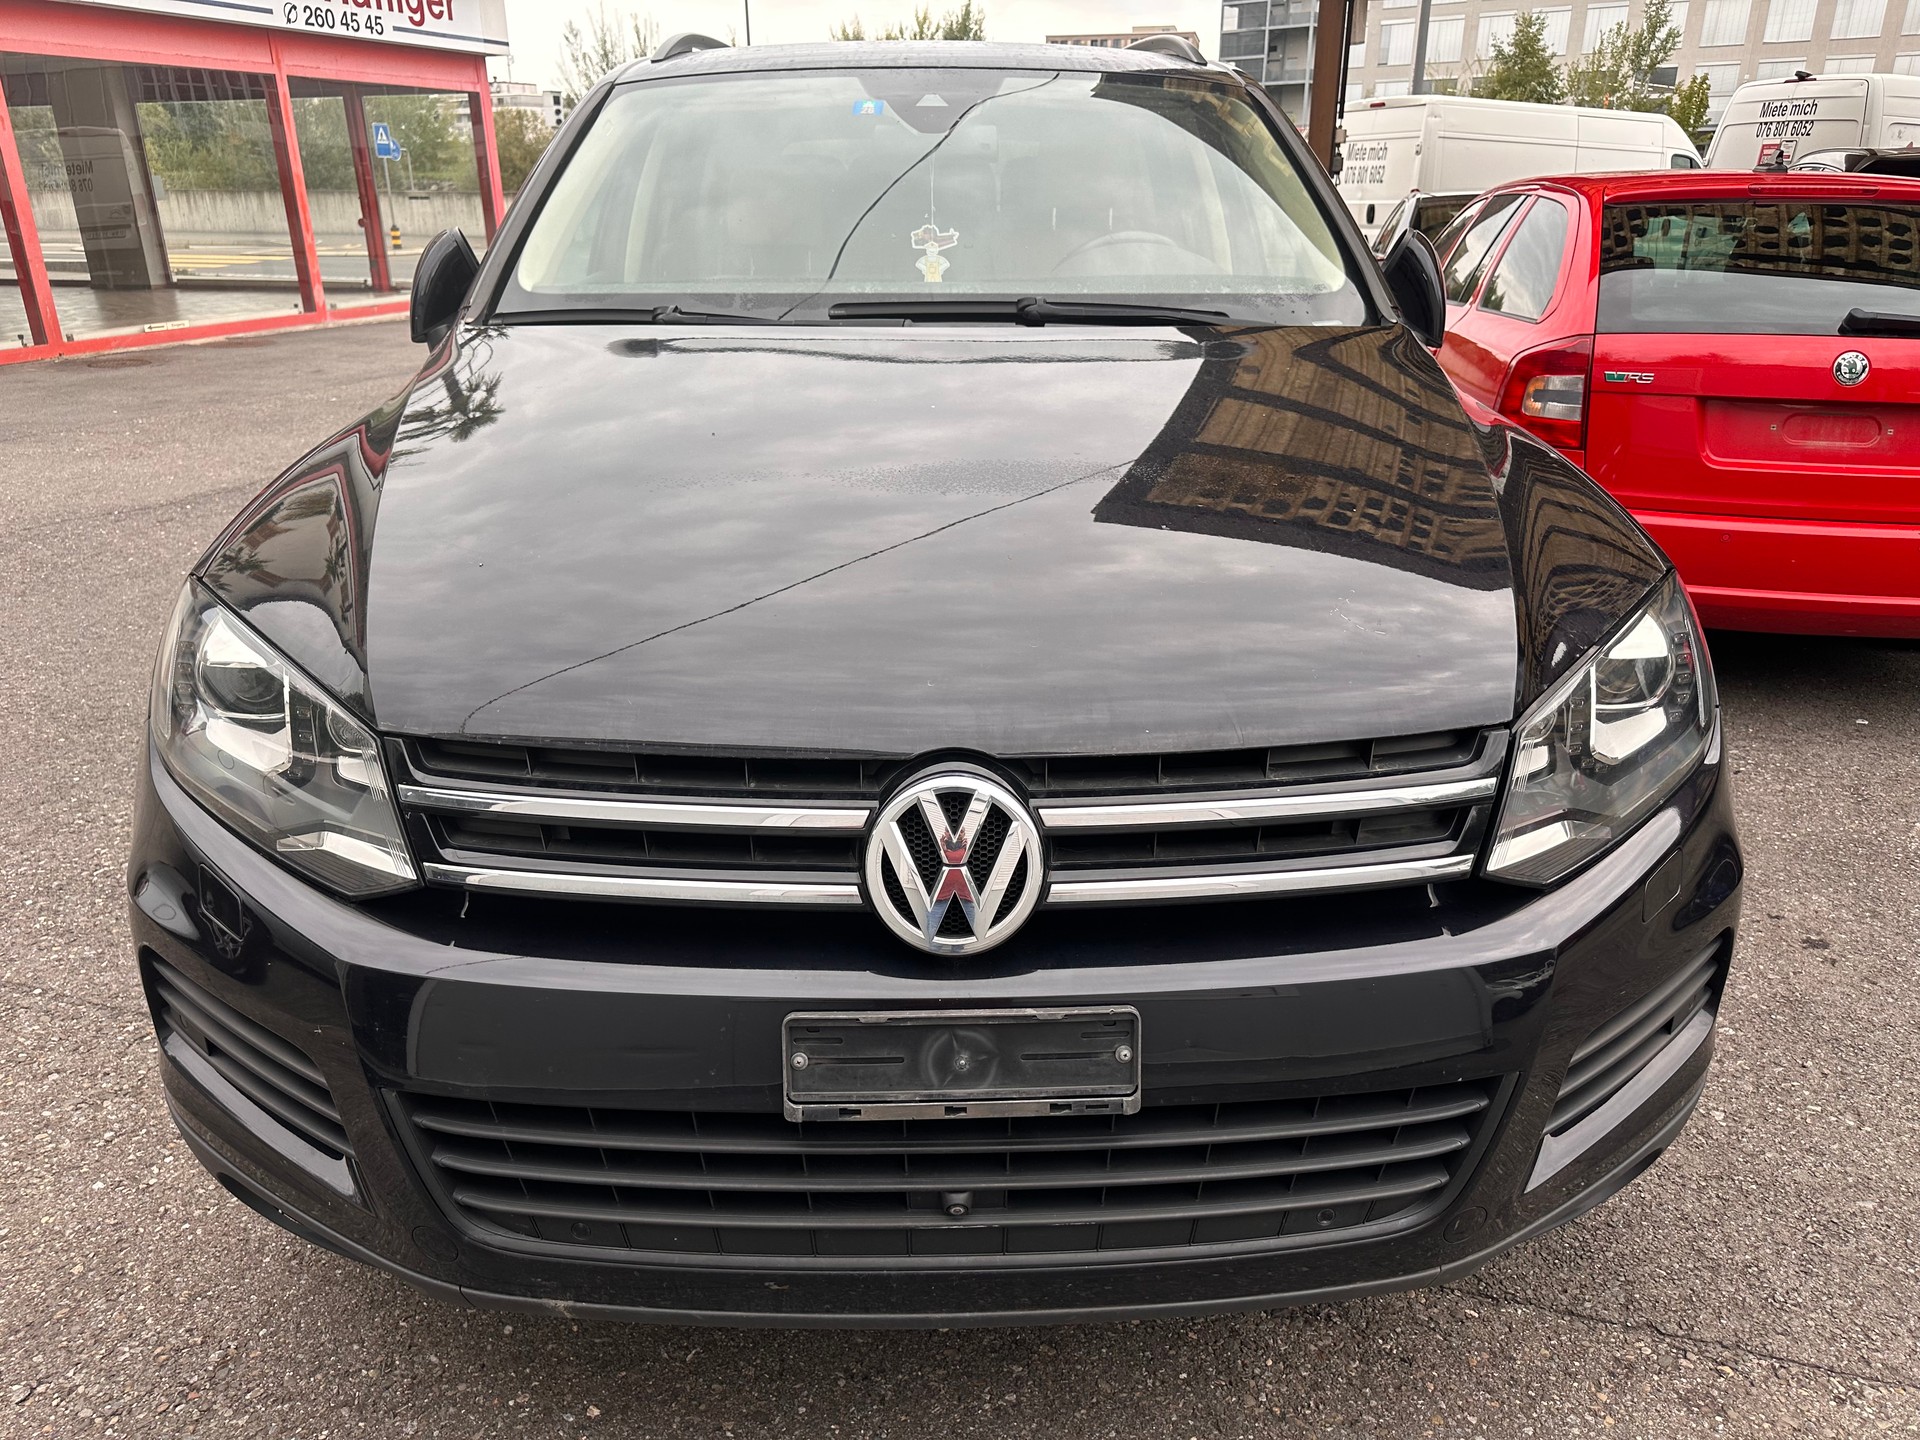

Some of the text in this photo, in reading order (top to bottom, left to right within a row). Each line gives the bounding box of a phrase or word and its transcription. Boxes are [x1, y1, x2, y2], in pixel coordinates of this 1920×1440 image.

[303, 6, 335, 29] 260
[340, 11, 360, 33] 45
[365, 14, 384, 35] 45
[1759, 99, 1818, 118] Miete mich
[1756, 120, 1815, 138] 076 801 6052
[1346, 142, 1388, 161] Miete mich
